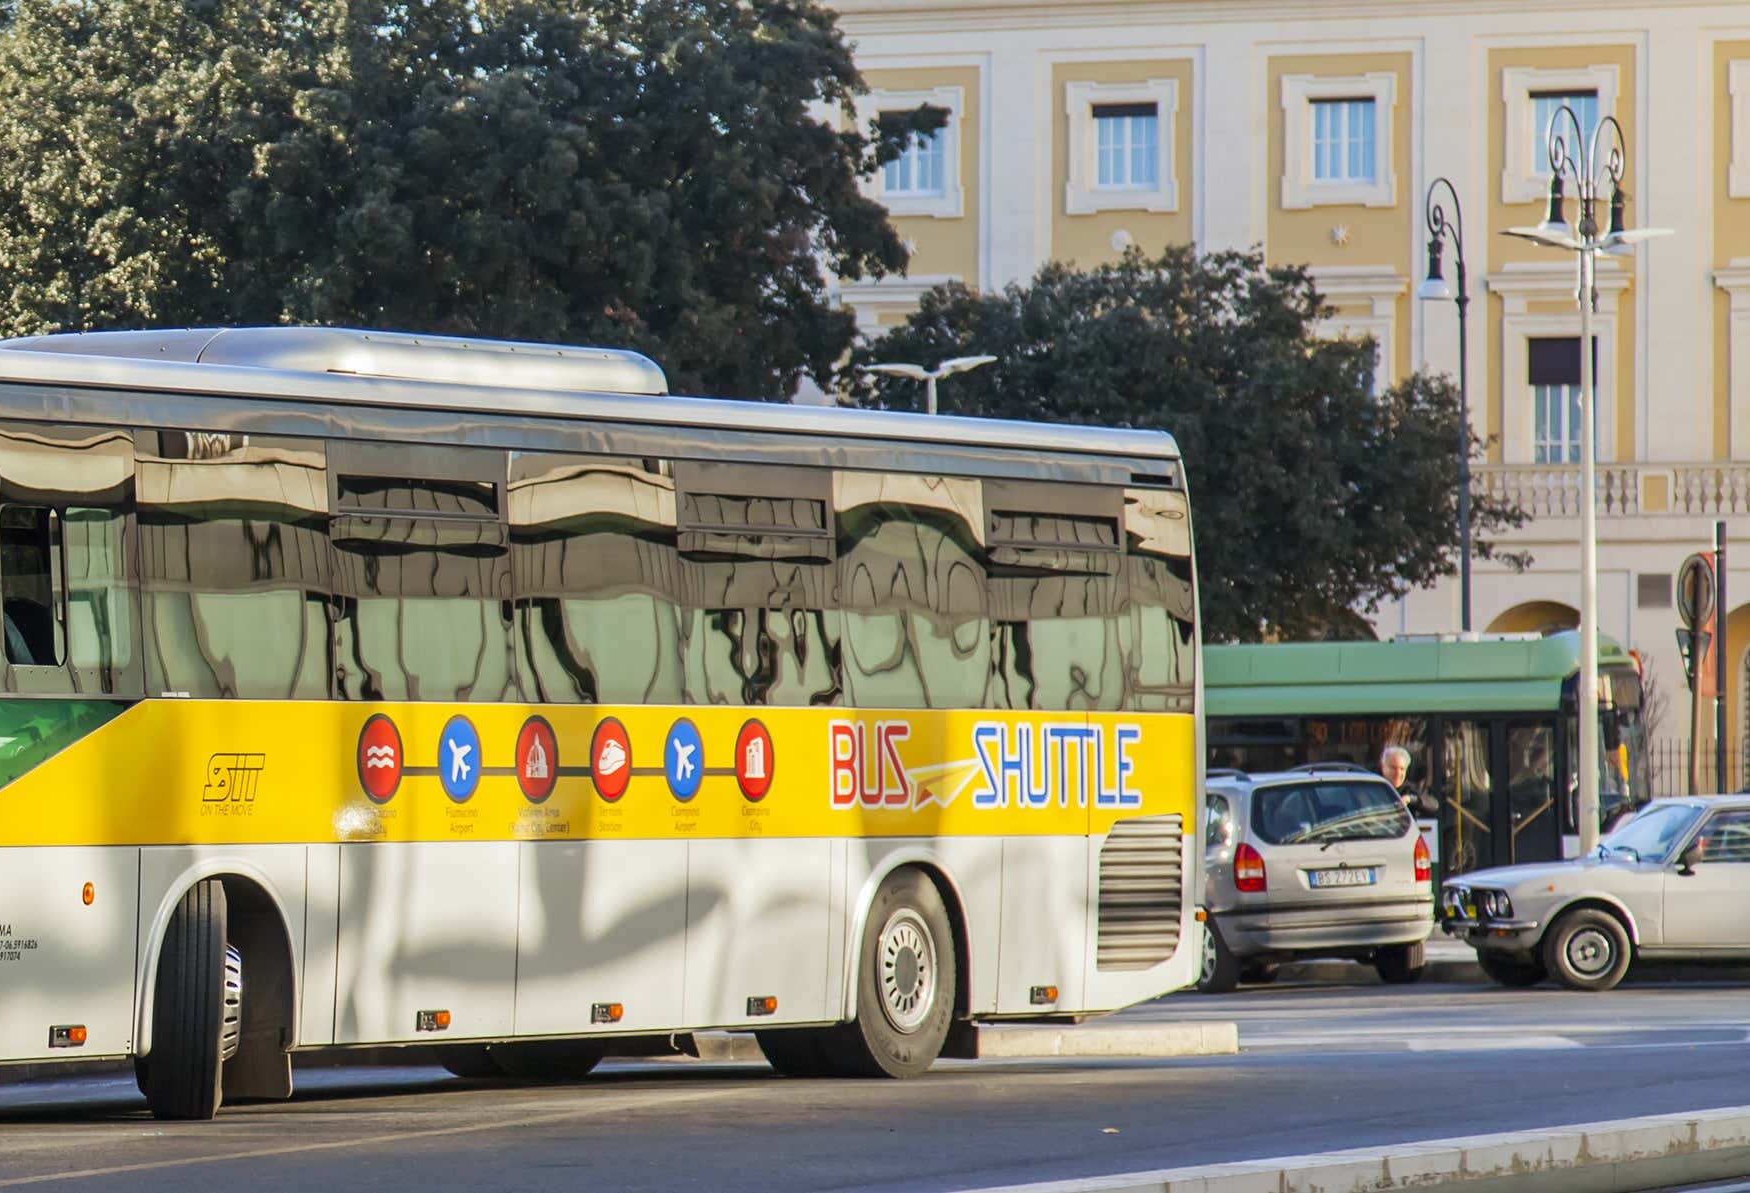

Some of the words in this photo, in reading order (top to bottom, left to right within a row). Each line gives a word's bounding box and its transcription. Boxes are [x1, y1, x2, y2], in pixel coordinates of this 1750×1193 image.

[830, 721, 910, 807] BUS
[972, 722, 1141, 808] SHUTTLE
[200, 804, 212, 816] ON
[215, 804, 229, 816] THE
[230, 804, 254, 816] MOVE
